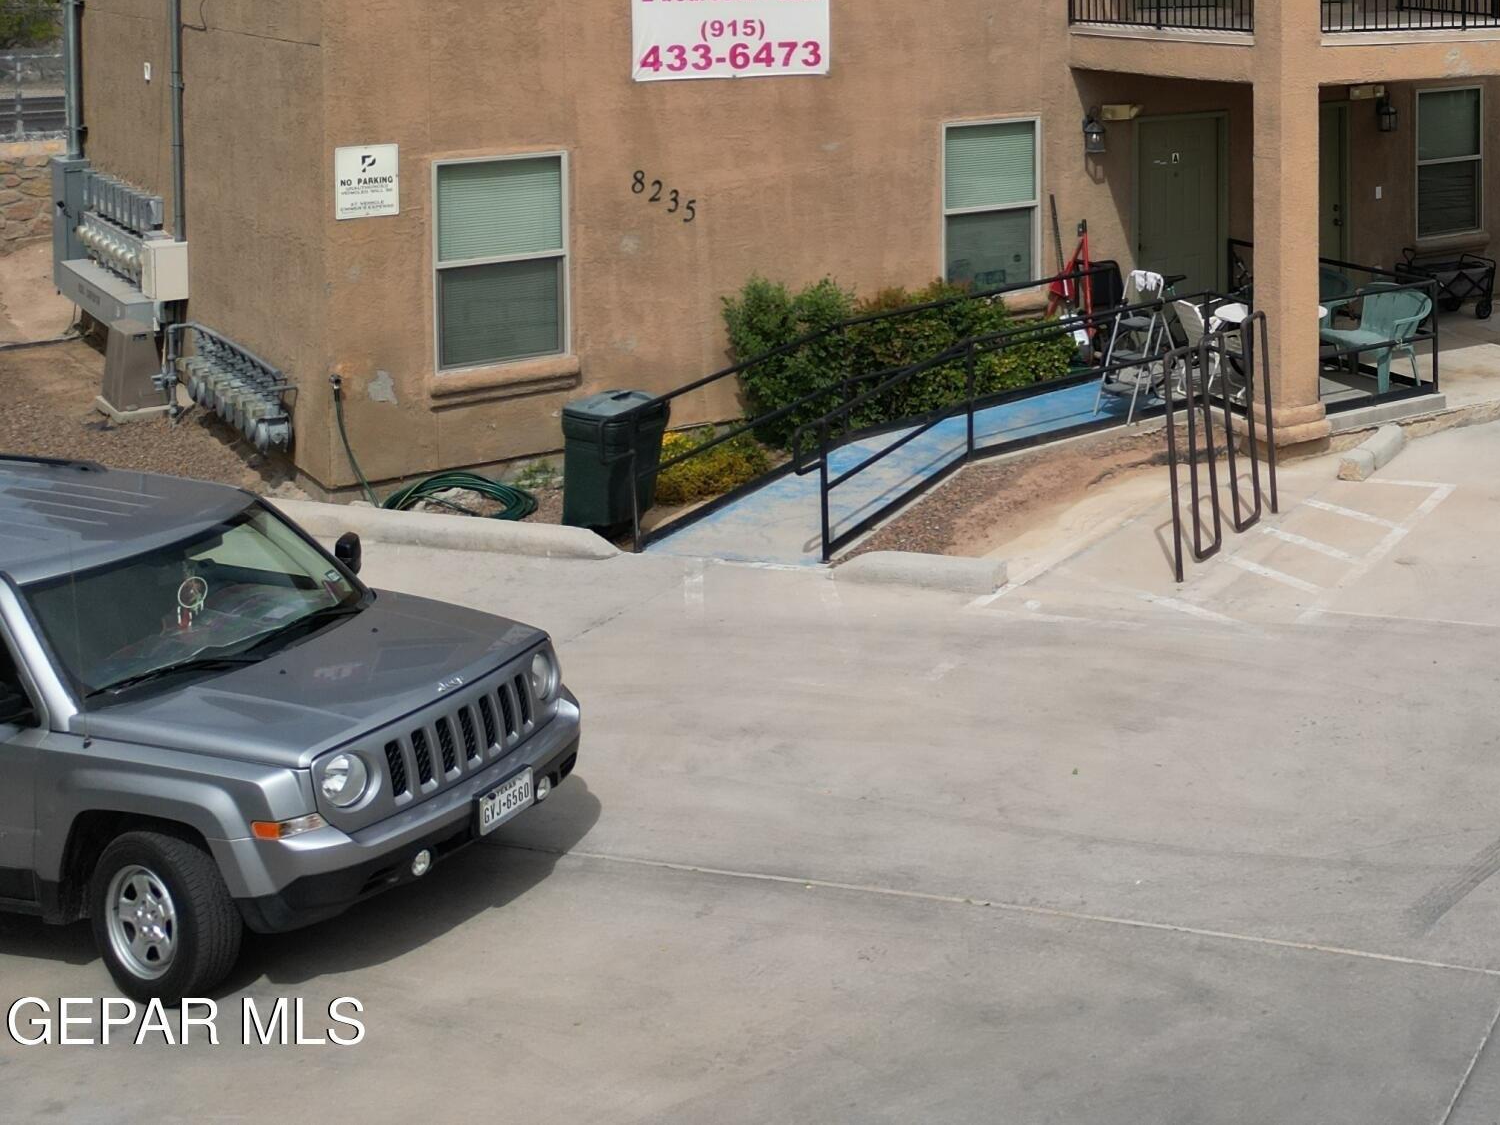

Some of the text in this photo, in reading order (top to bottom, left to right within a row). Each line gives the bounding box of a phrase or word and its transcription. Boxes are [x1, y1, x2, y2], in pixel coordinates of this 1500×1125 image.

[701, 19, 765, 42] (915)
[640, 41, 822, 72] 433-6473
[357, 176, 393, 185] PARKING
[631, 170, 697, 223] 8235
